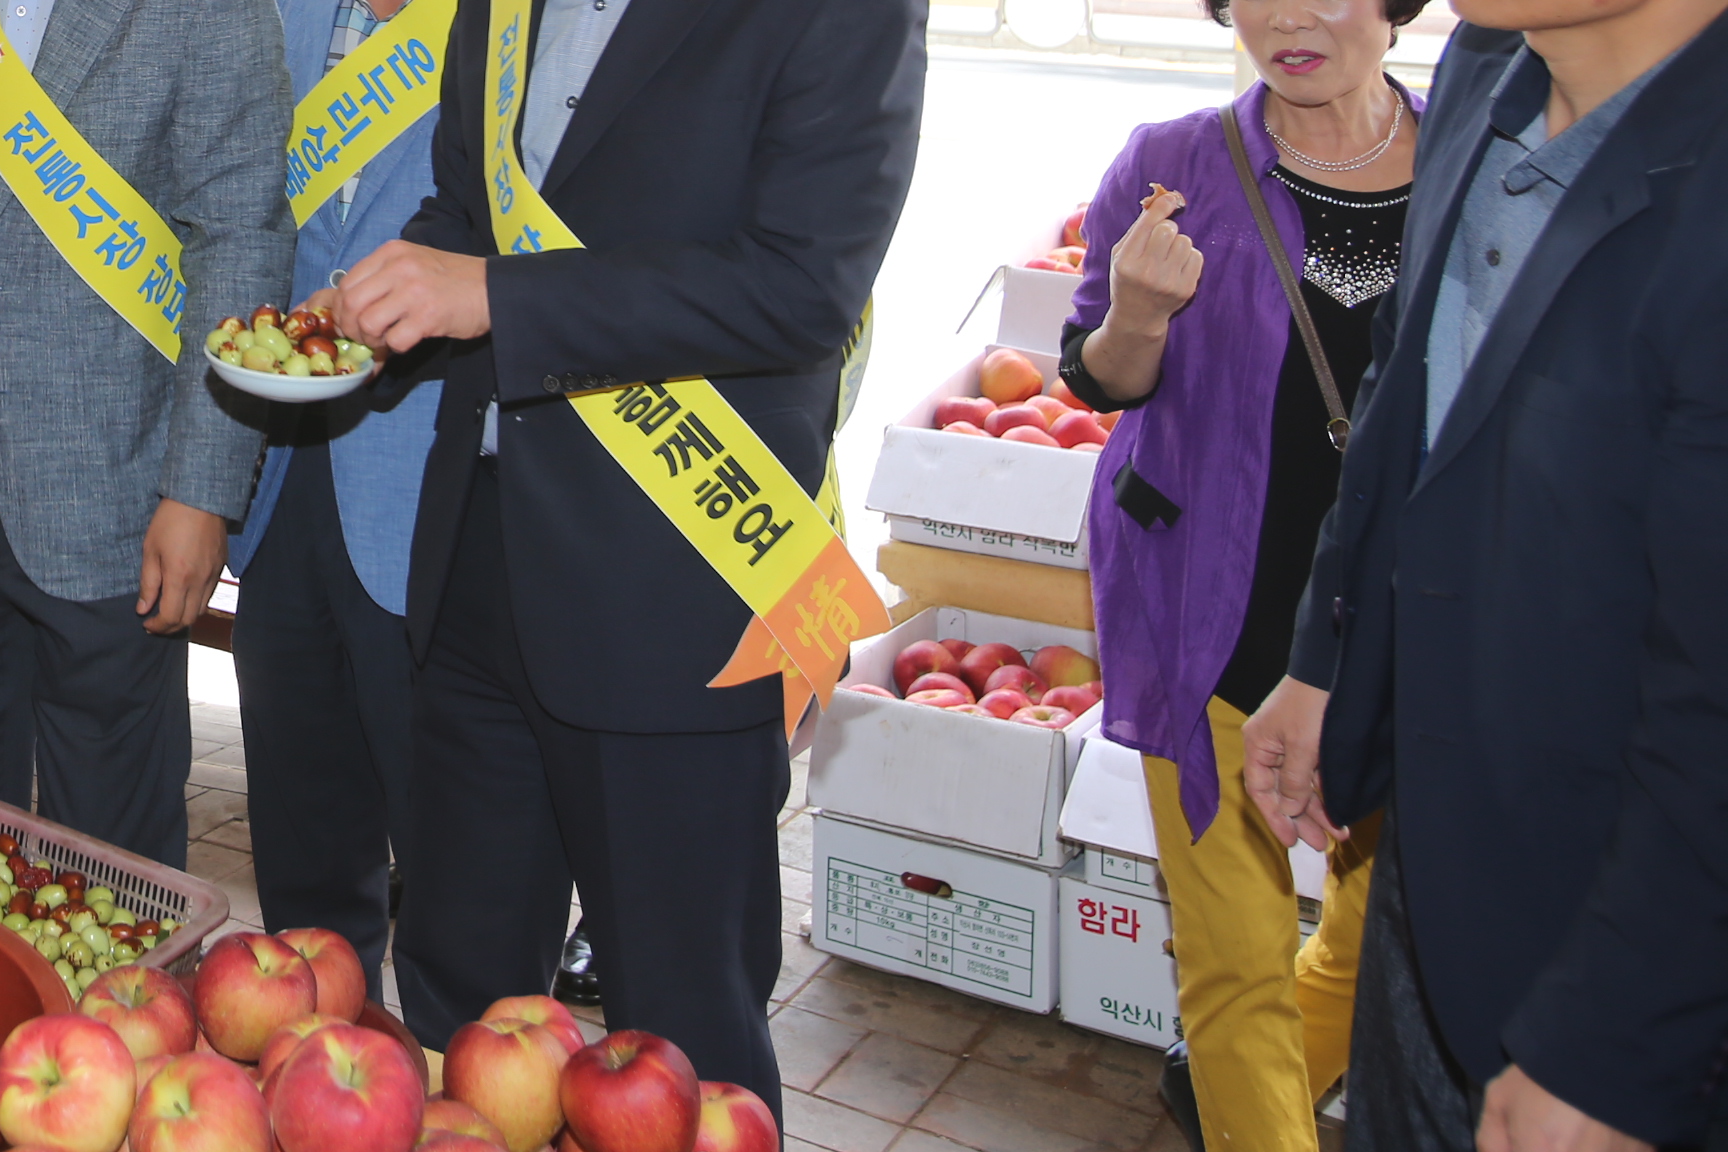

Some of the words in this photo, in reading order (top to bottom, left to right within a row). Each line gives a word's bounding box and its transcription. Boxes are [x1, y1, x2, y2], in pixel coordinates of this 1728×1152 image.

[2, 111, 148, 271] 전통시장
[612, 382, 795, 567] 함께해요
[1077, 898, 1141, 943] 함라
[1099, 996, 1162, 1032] 익산시
